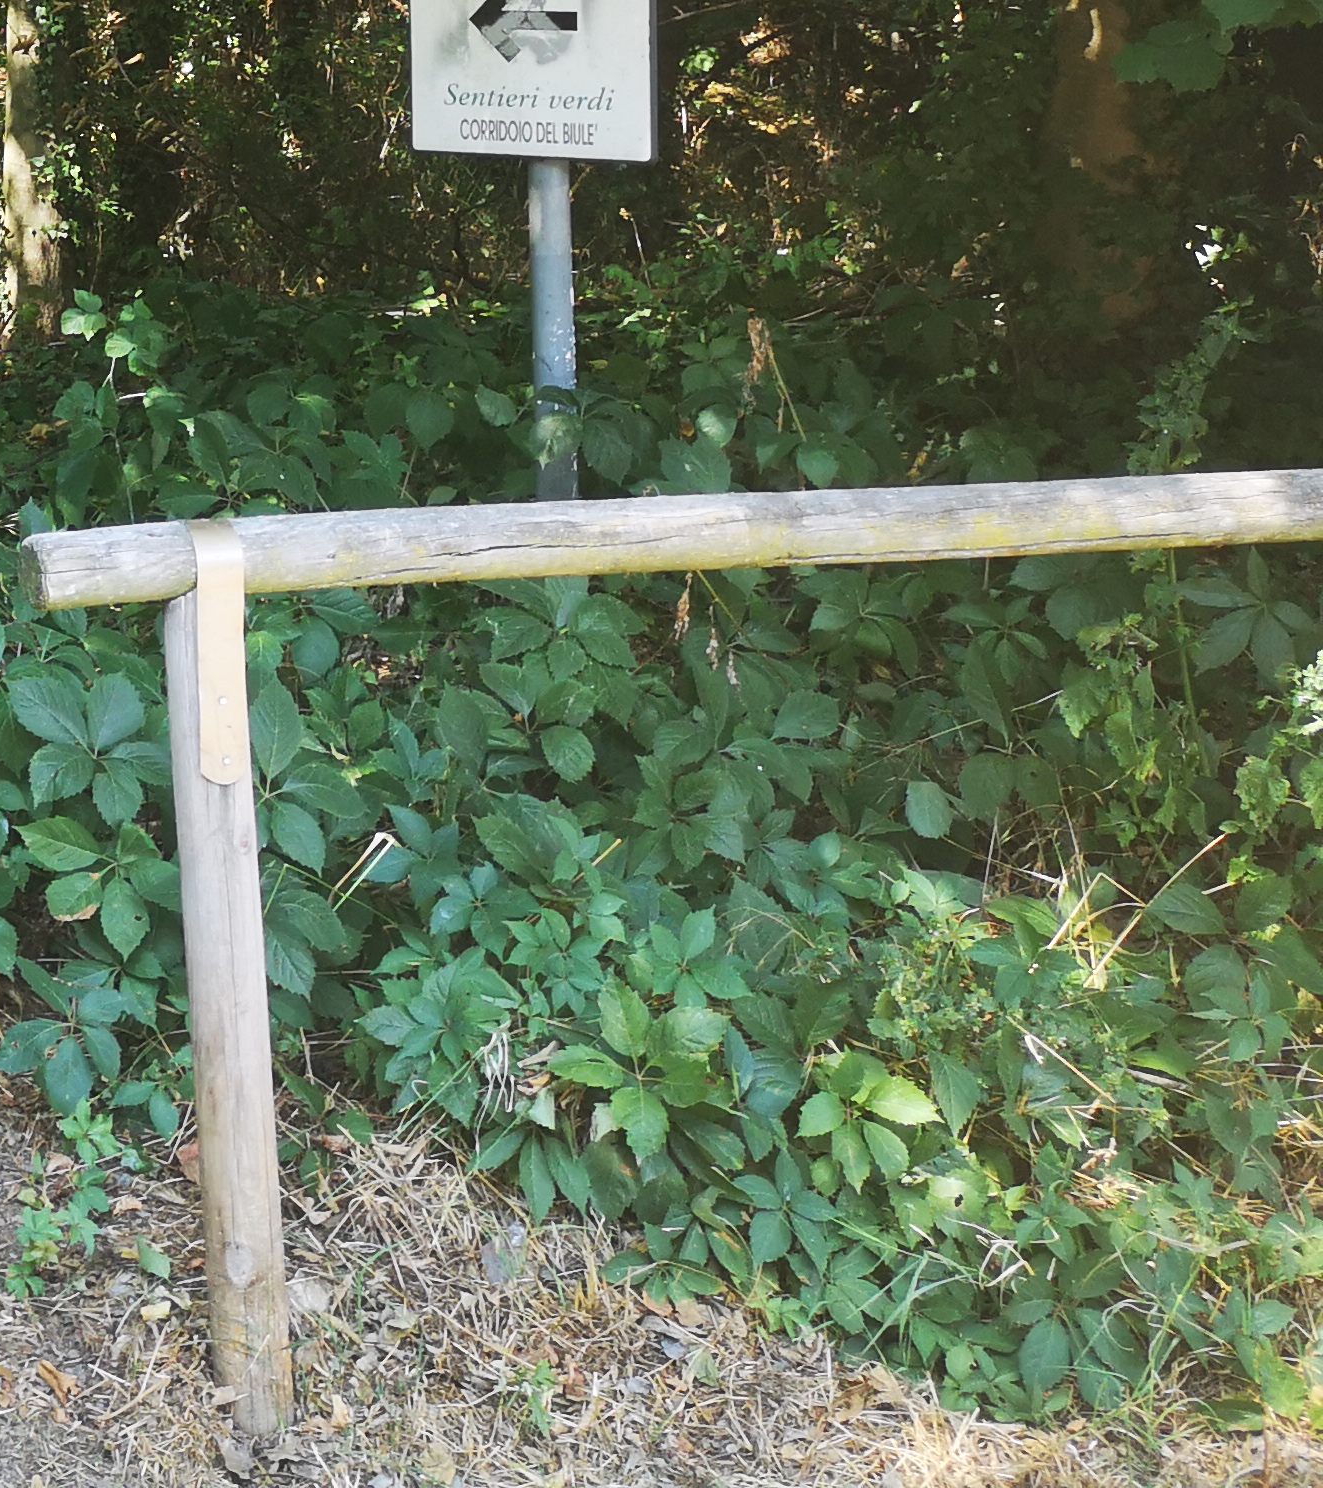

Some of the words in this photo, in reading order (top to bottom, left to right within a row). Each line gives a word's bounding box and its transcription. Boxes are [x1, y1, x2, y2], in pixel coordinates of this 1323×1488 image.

[443, 83, 540, 109] Sentieri
[549, 86, 615, 111] verdi
[460, 118, 532, 143] CORRIDOIO
[536, 121, 559, 144] DEL
[563, 123, 598, 146] BIULE'
